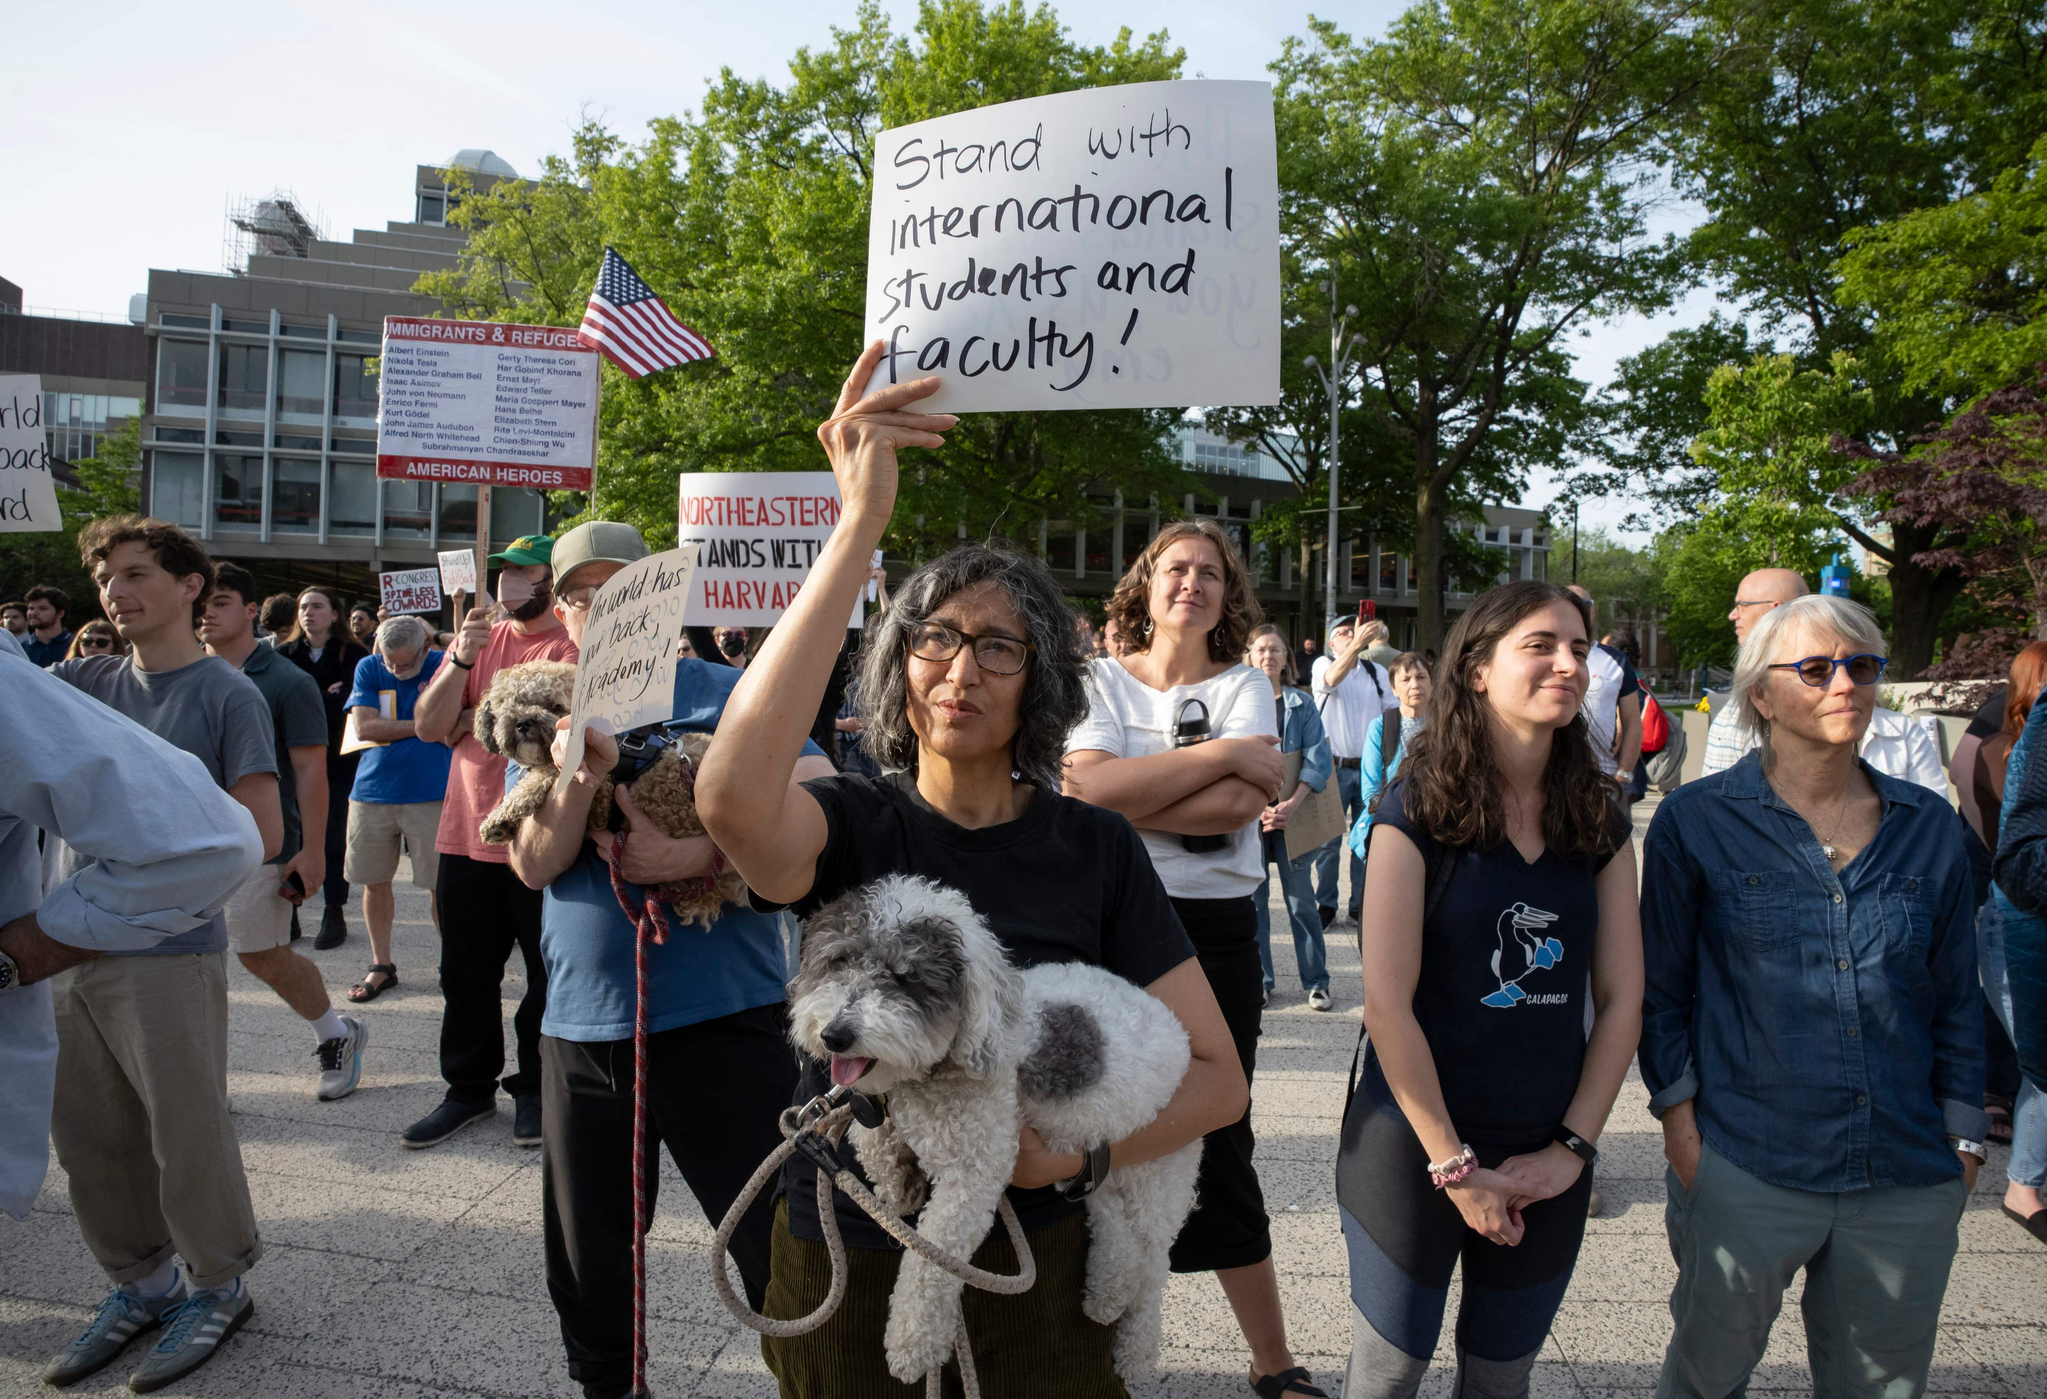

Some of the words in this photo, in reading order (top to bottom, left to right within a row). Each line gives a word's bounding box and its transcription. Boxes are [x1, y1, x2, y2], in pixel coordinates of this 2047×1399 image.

[894, 122, 1042, 191] Stand
[1089, 105, 1191, 160] with
[891, 167, 1233, 256] international
[878, 255, 1077, 324] students
[1097, 248, 1195, 296] and
[491, 326, 505, 343] &
[511, 330, 588, 349] REFUGE
[389, 346, 414, 355] Albert
[416, 348, 450, 357] Einstein
[387, 357, 414, 366] Nikola
[416, 358, 438, 367] Tesla
[498, 353, 521, 364] Gerty
[524, 355, 556, 365] Theresa
[558, 357, 576, 366] Cori
[387, 367, 429, 377] Alexander
[431, 370, 464, 379] Graham
[466, 372, 482, 380] Bell
[497, 364, 512, 372] Har
[514, 365, 544, 374] Gobind
[546, 368, 582, 377] Khorana
[386, 378, 408, 386] Isaac
[410, 379, 441, 388] Asimov
[497, 374, 519, 383] Ernst
[521, 376, 541, 385] Mayr
[386, 388, 407, 396] John
[427, 390, 466, 400] Neumann
[496, 384, 528, 394] Edward
[530, 386, 552, 395] Teller
[386, 398, 412, 407] Enrico
[414, 400, 438, 408] Fermi
[495, 395, 519, 404] Maria
[521, 396, 559, 407] Goeppert
[561, 399, 586, 409] Mayer
[385, 409, 403, 417] Kurt
[405, 410, 430, 418] Gödel
[495, 405, 517, 414] Hans
[519, 406, 543, 415] Bethe
[385, 419, 405, 427] John
[407, 420, 434, 429] James
[436, 422, 474, 431] Audubon
[494, 415, 533, 426] Elizabeth
[534, 418, 557, 427] Stern
[384, 429, 409, 438] Alfred
[411, 431, 434, 439] North
[436, 432, 480, 442] Whitehead
[494, 426, 511, 434] Rita
[513, 427, 576, 438] Levi-Montalcini
[493, 436, 549, 449] Chien-Shiung
[552, 440, 565, 448] Wu
[422, 442, 484, 454] Subrahmanyan
[486, 446, 549, 458] Chandrasekhar
[406, 462, 491, 480] AMERICAN
[496, 467, 563, 484] HEROES
[770, 539, 824, 569] WIT
[607, 566, 649, 615] world
[652, 562, 685, 593] has
[704, 580, 801, 610] HARVAR
[385, 595, 439, 612] COWARDS
[609, 605, 660, 648] back,
